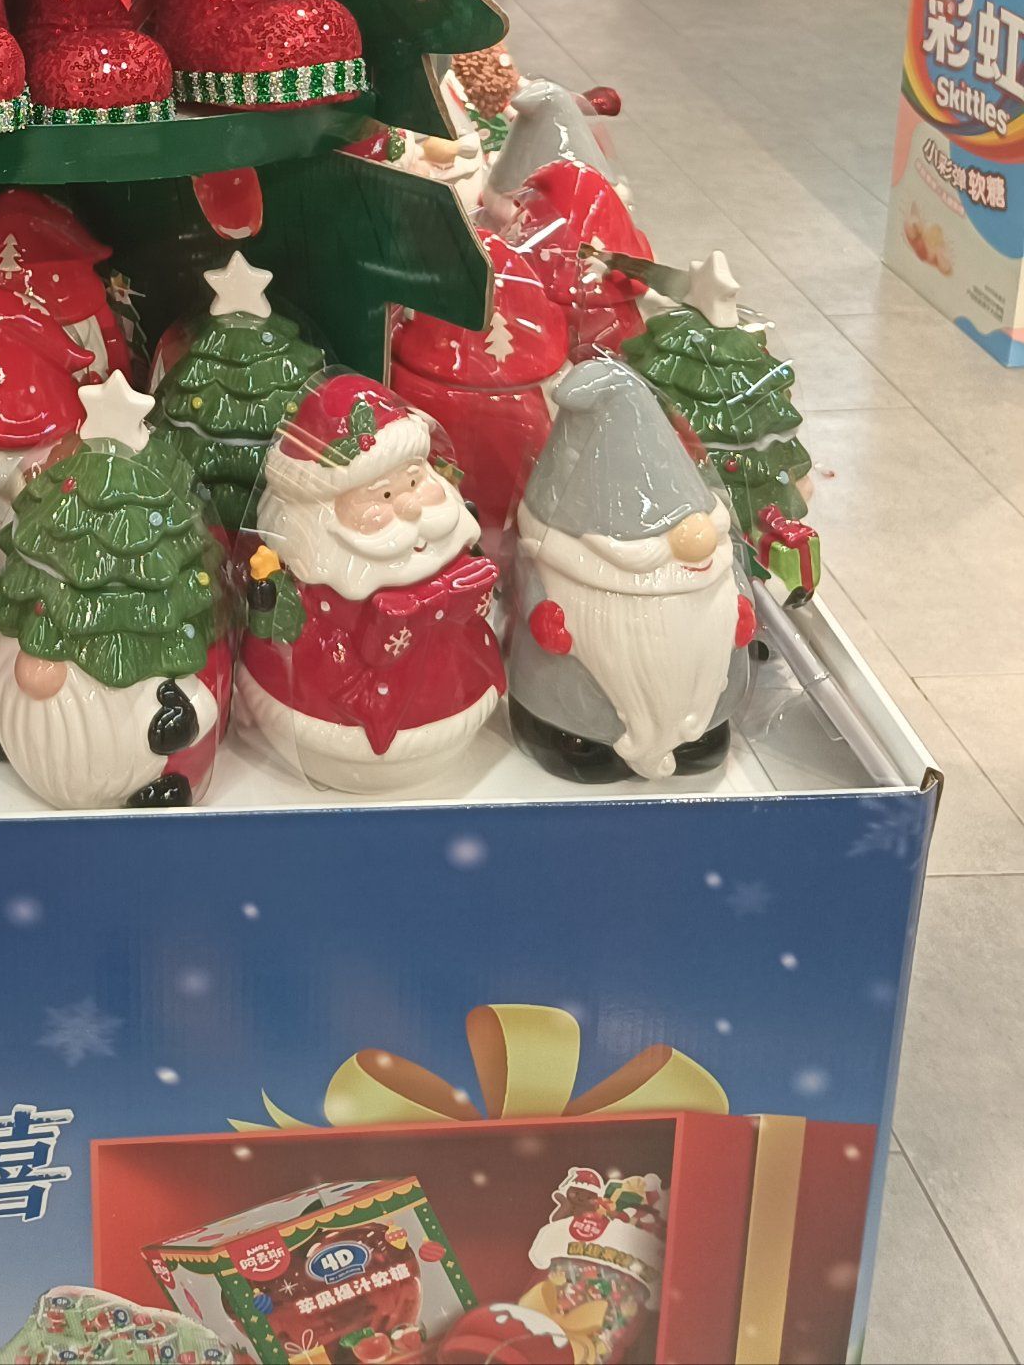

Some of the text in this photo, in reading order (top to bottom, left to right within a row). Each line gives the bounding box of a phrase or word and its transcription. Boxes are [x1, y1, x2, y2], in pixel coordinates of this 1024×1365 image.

[936, 76, 1007, 134] Skittles
[240, 1247, 286, 1271] 阿麦斯
[321, 1248, 354, 1272] 4D
[296, 1263, 412, 1315] 苹果爆汁软糖
